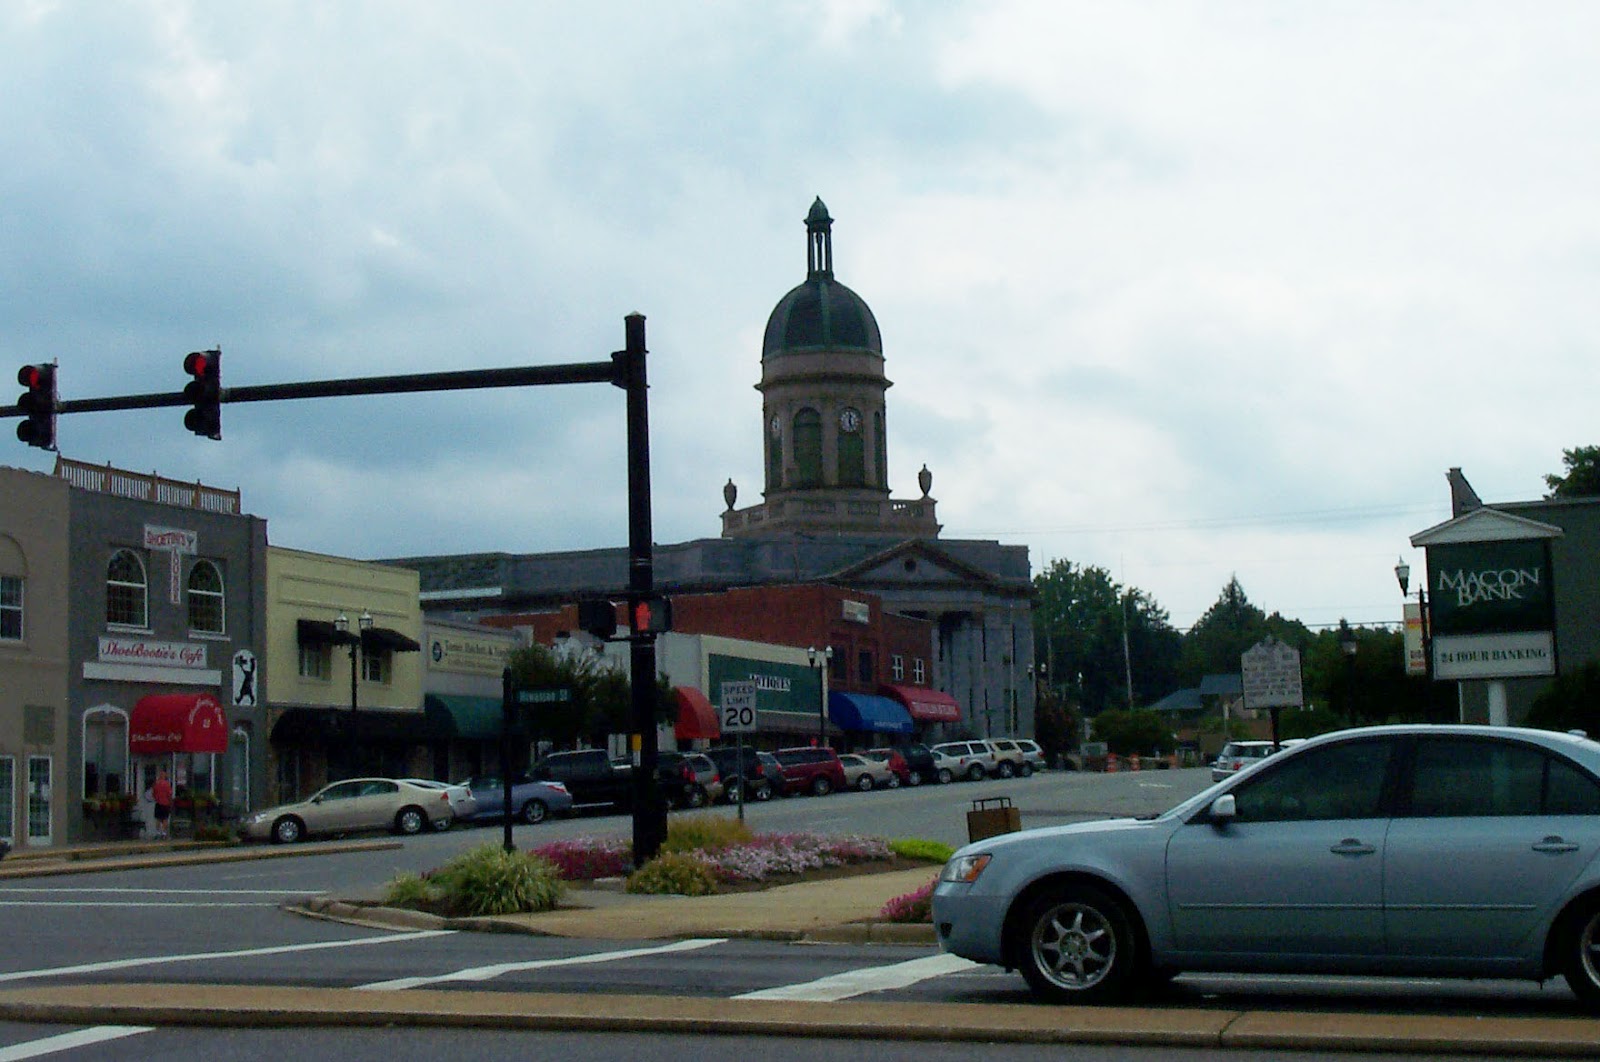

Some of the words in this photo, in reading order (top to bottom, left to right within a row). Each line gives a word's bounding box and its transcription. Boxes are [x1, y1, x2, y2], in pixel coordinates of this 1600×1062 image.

[1438, 567, 1540, 591] MACON
[1458, 583, 1523, 606] BANK
[1457, 650, 1489, 662] HOUR
[1492, 648, 1546, 660] BANKING
[723, 686, 754, 694] SPEED
[727, 697, 750, 705] LIMIT
[726, 707, 753, 726] 20
